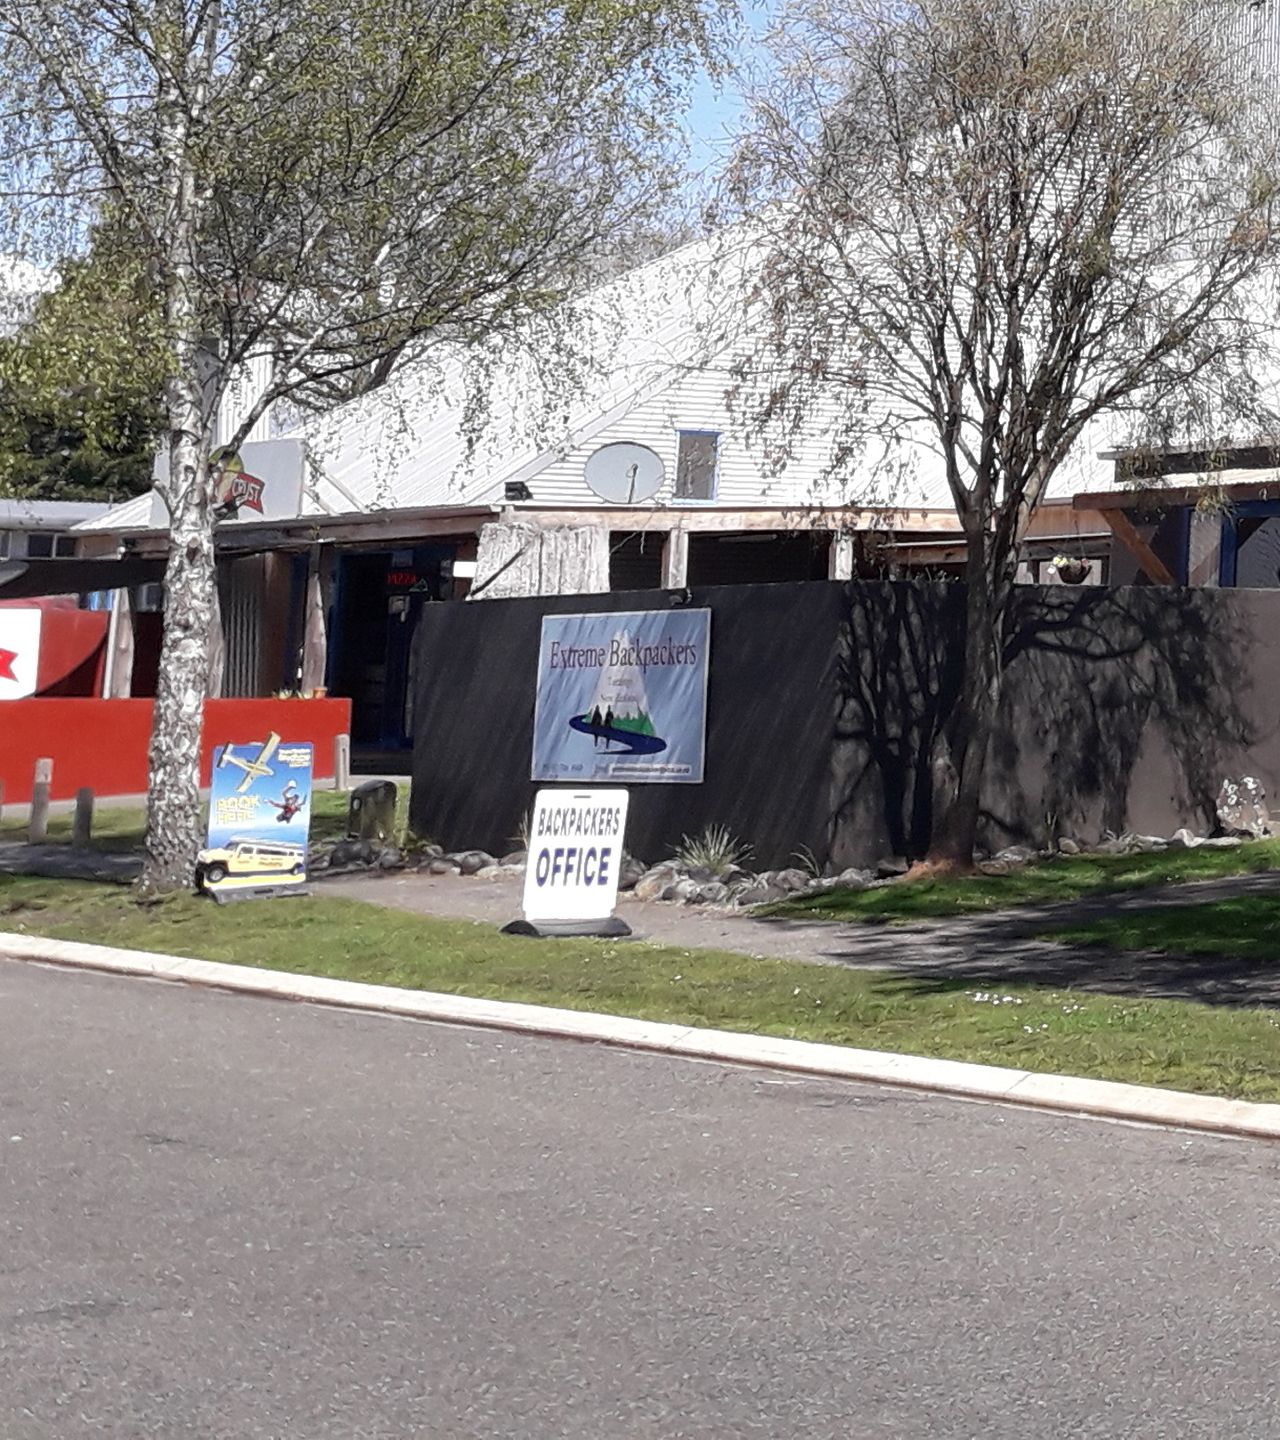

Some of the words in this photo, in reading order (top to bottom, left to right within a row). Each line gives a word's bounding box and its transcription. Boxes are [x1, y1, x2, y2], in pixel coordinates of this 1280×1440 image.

[550, 641, 606, 670] Extreme
[608, 637, 697, 673] Backpackers
[538, 807, 620, 836] BACKPACKERS
[536, 846, 611, 887] OFFICE
